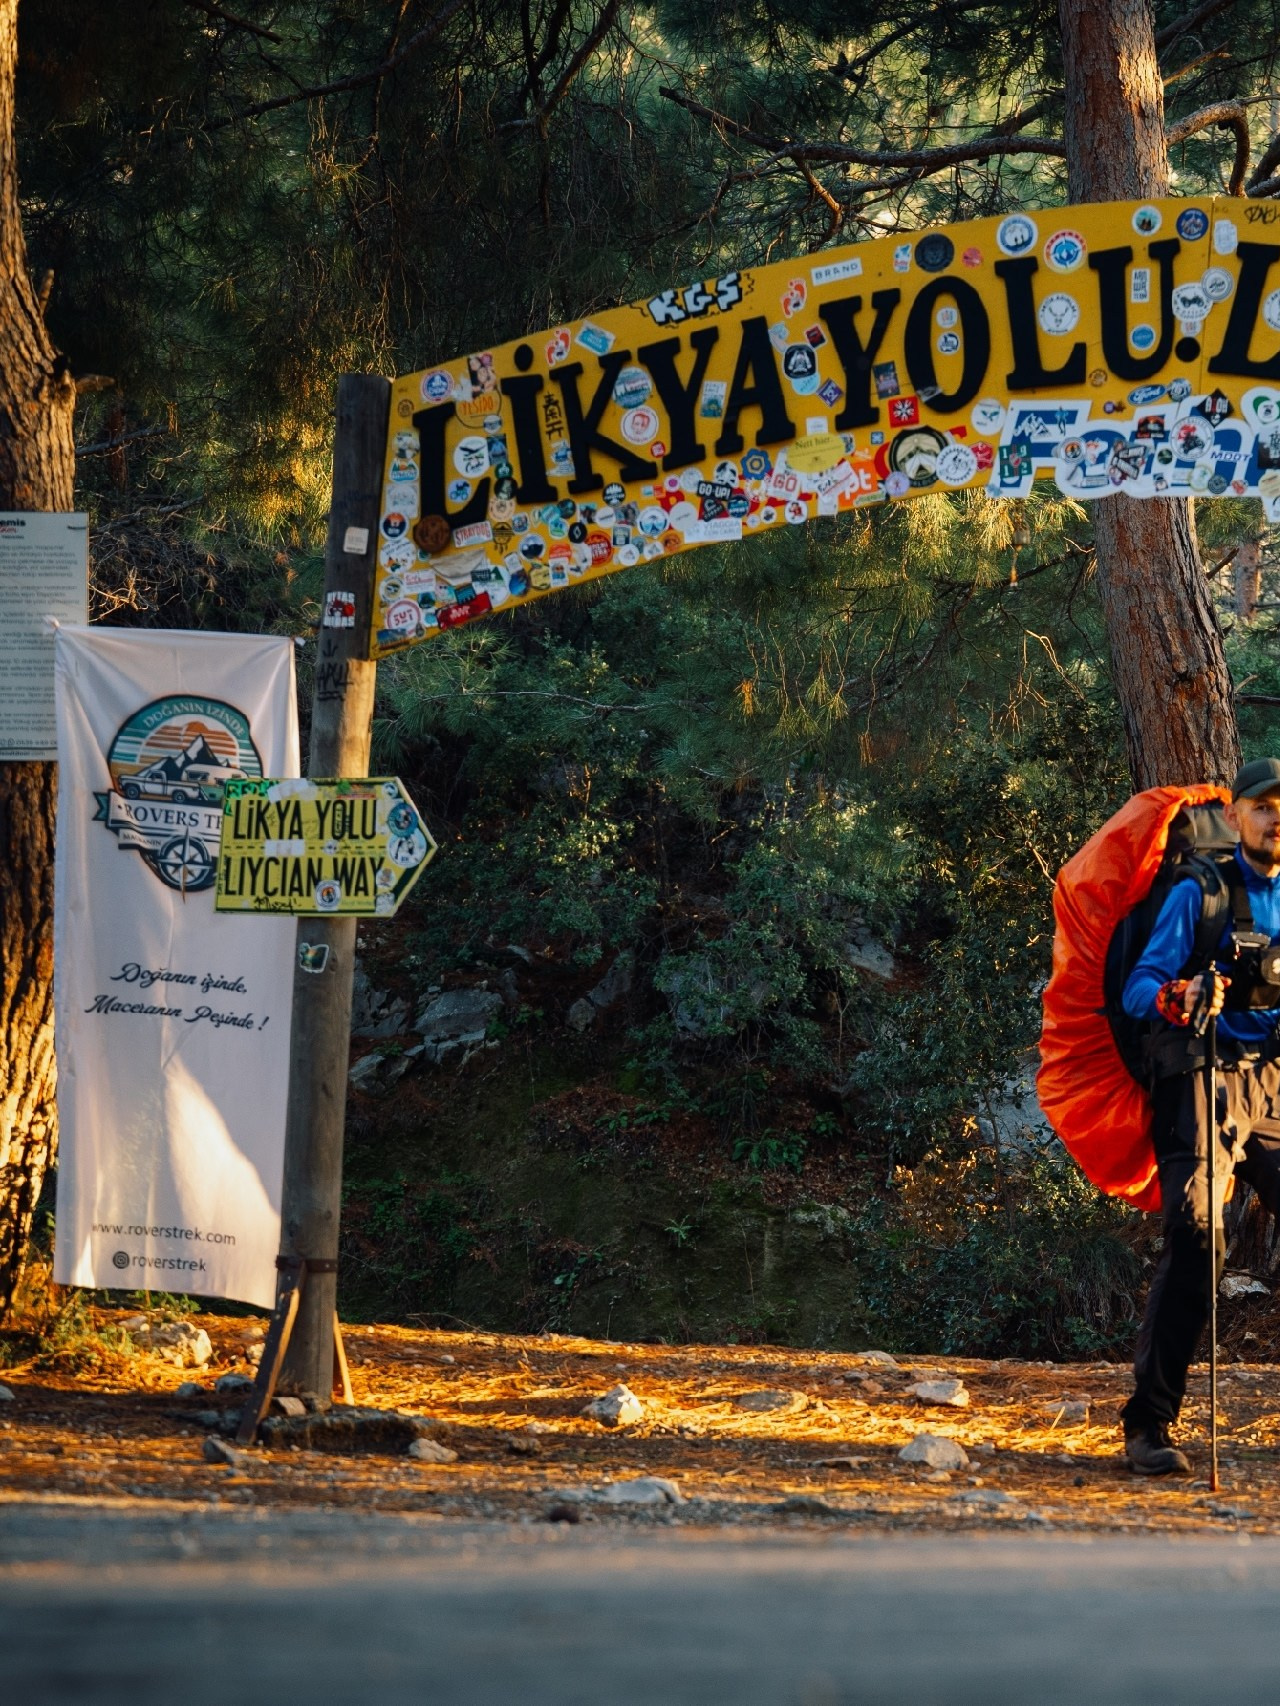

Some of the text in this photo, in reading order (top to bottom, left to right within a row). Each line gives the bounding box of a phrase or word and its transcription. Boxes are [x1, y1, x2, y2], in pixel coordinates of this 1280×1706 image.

[814, 262, 859, 280] BRAND
[648, 271, 744, 328] KGS
[412, 315, 796, 532] LİKYA
[143, 700, 204, 728] DOĞANIN
[124, 804, 200, 827] ROVERS
[315, 798, 377, 840] YOLU
[332, 856, 386, 898] WAY
[109, 962, 198, 989] Doğanın
[84, 994, 182, 1019] Maceranın
[183, 1005, 254, 1031] Peşinde
[91, 1220, 237, 1247] www.roverstrek.com
